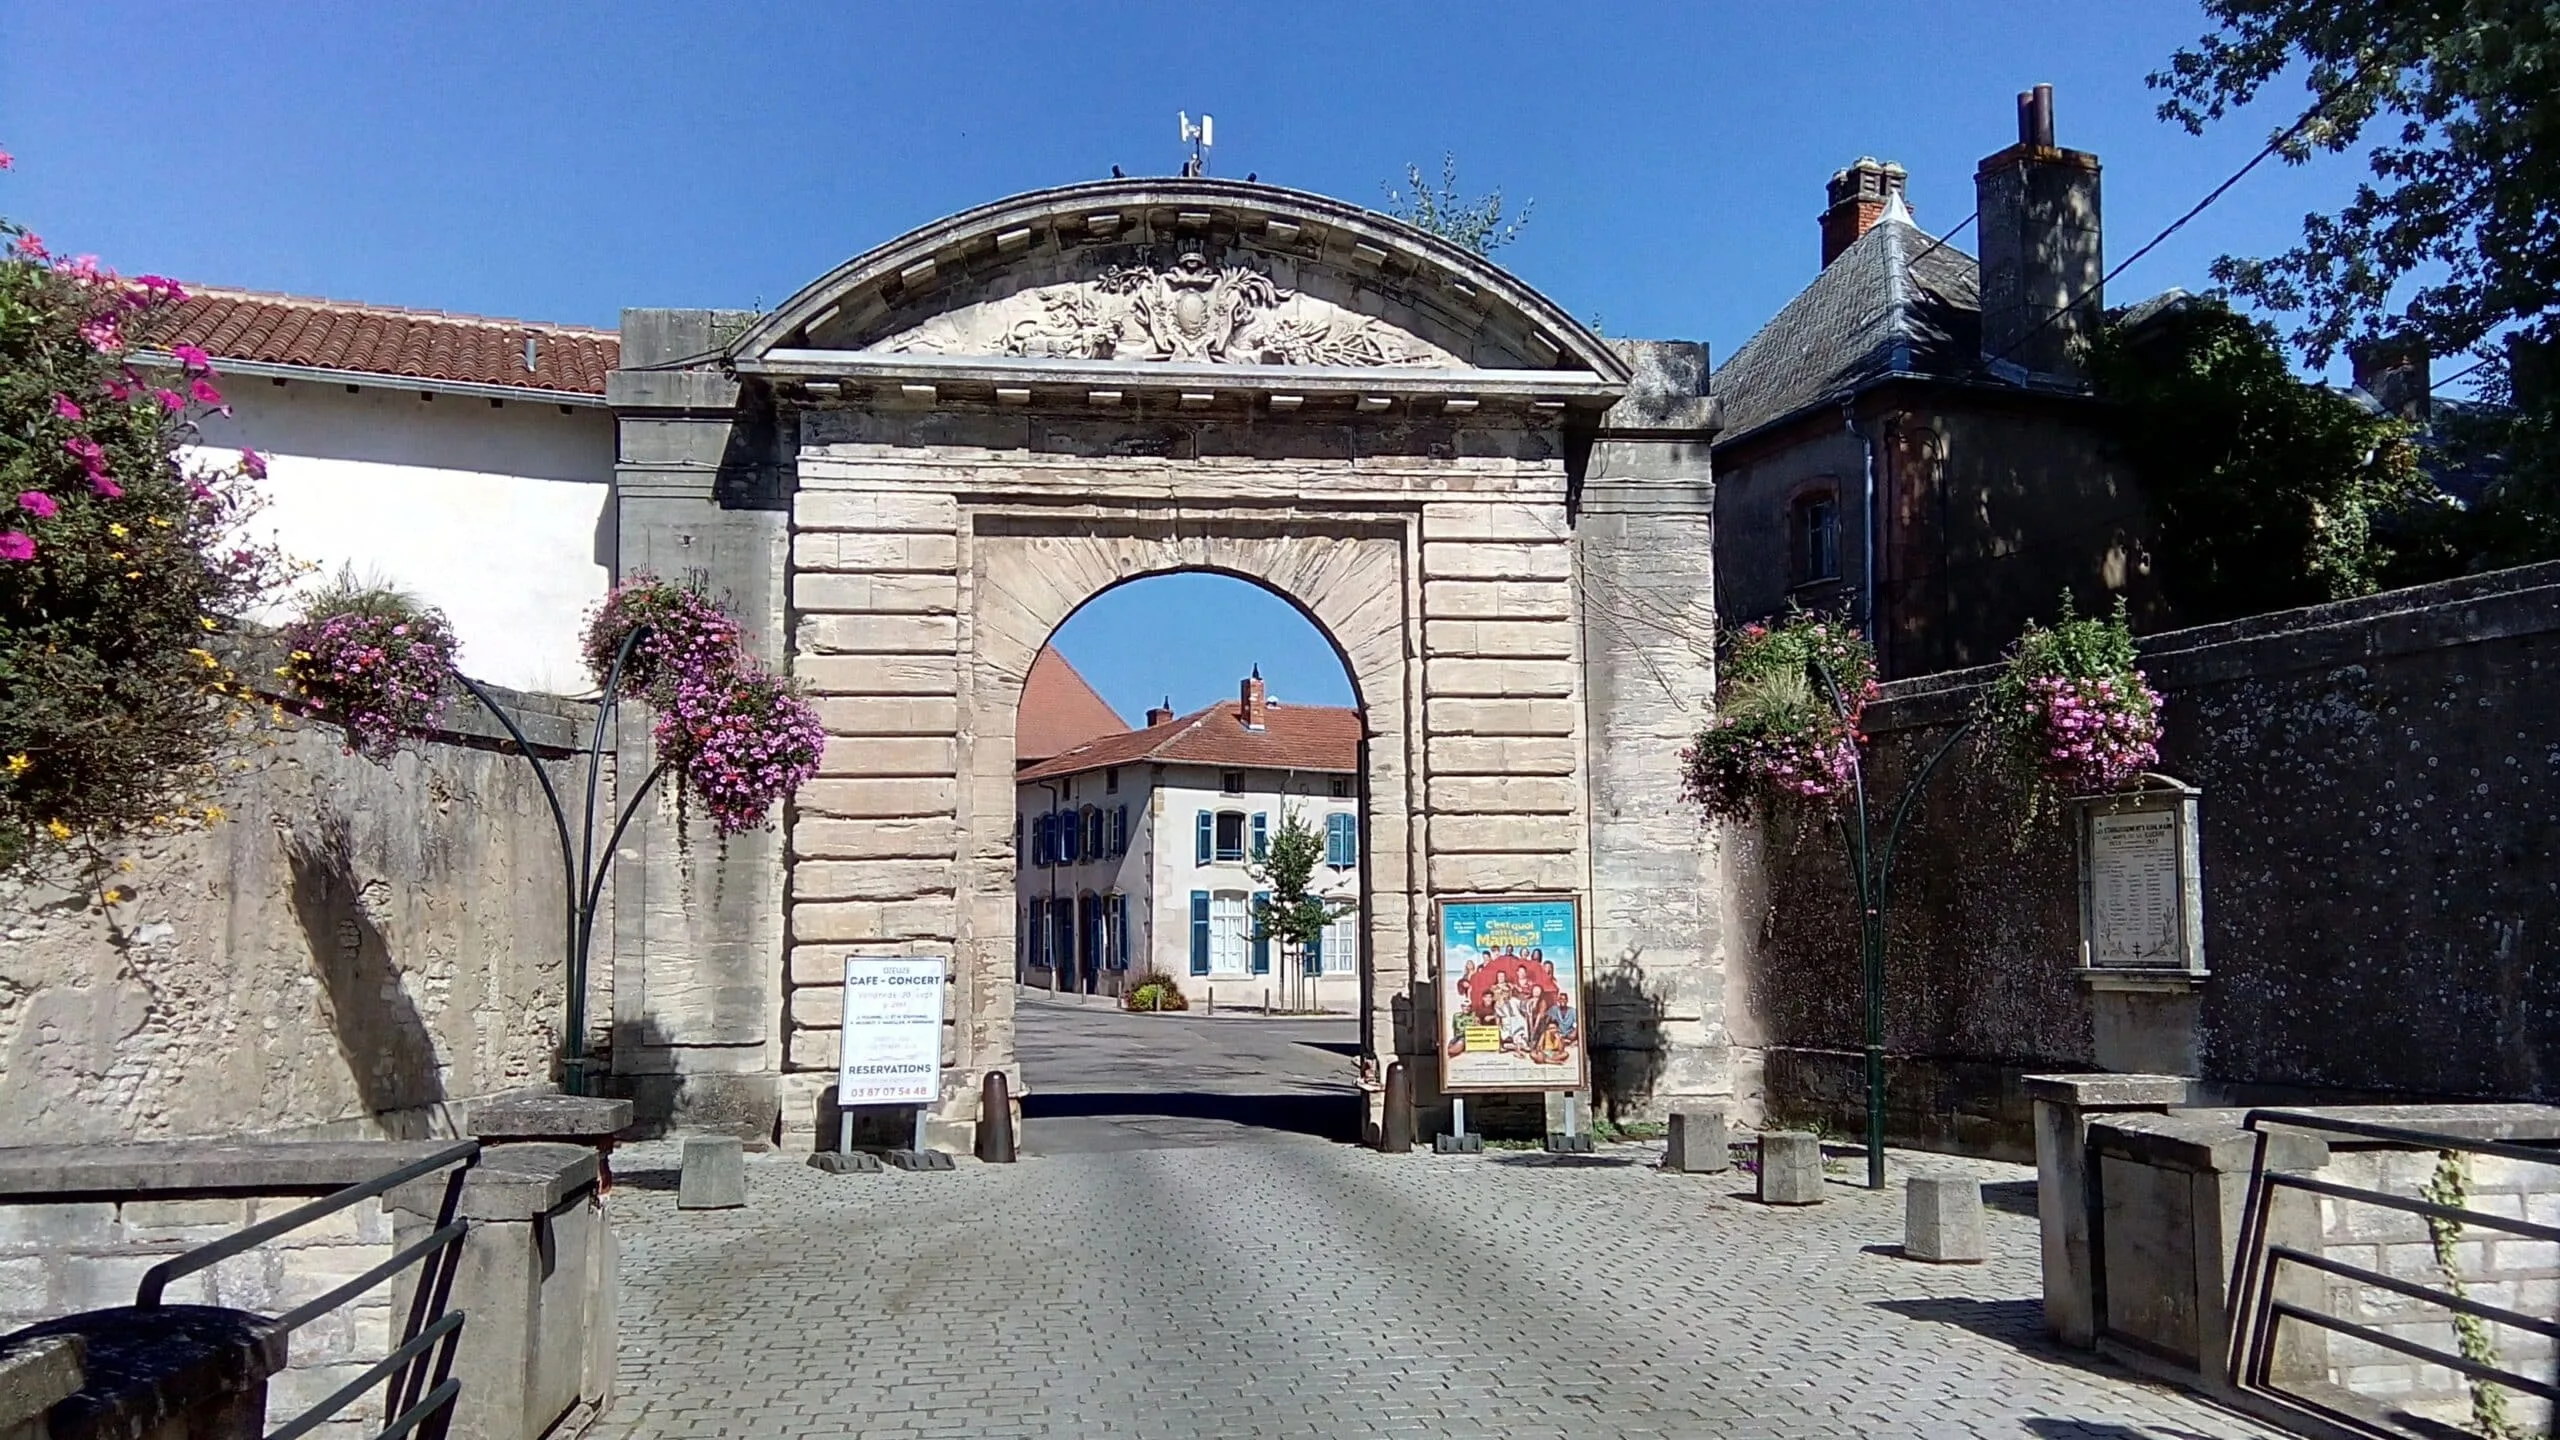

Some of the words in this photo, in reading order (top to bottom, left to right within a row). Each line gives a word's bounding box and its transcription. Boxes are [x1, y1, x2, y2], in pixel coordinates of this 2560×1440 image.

[1511, 920, 1534, 930] quoi
[850, 976, 878, 985] CAFE
[888, 976, 940, 985] CONCERT
[849, 1064, 932, 1074] RESERVATIONS
[883, 1087, 895, 1096] 07
[898, 1086, 910, 1095] 54
